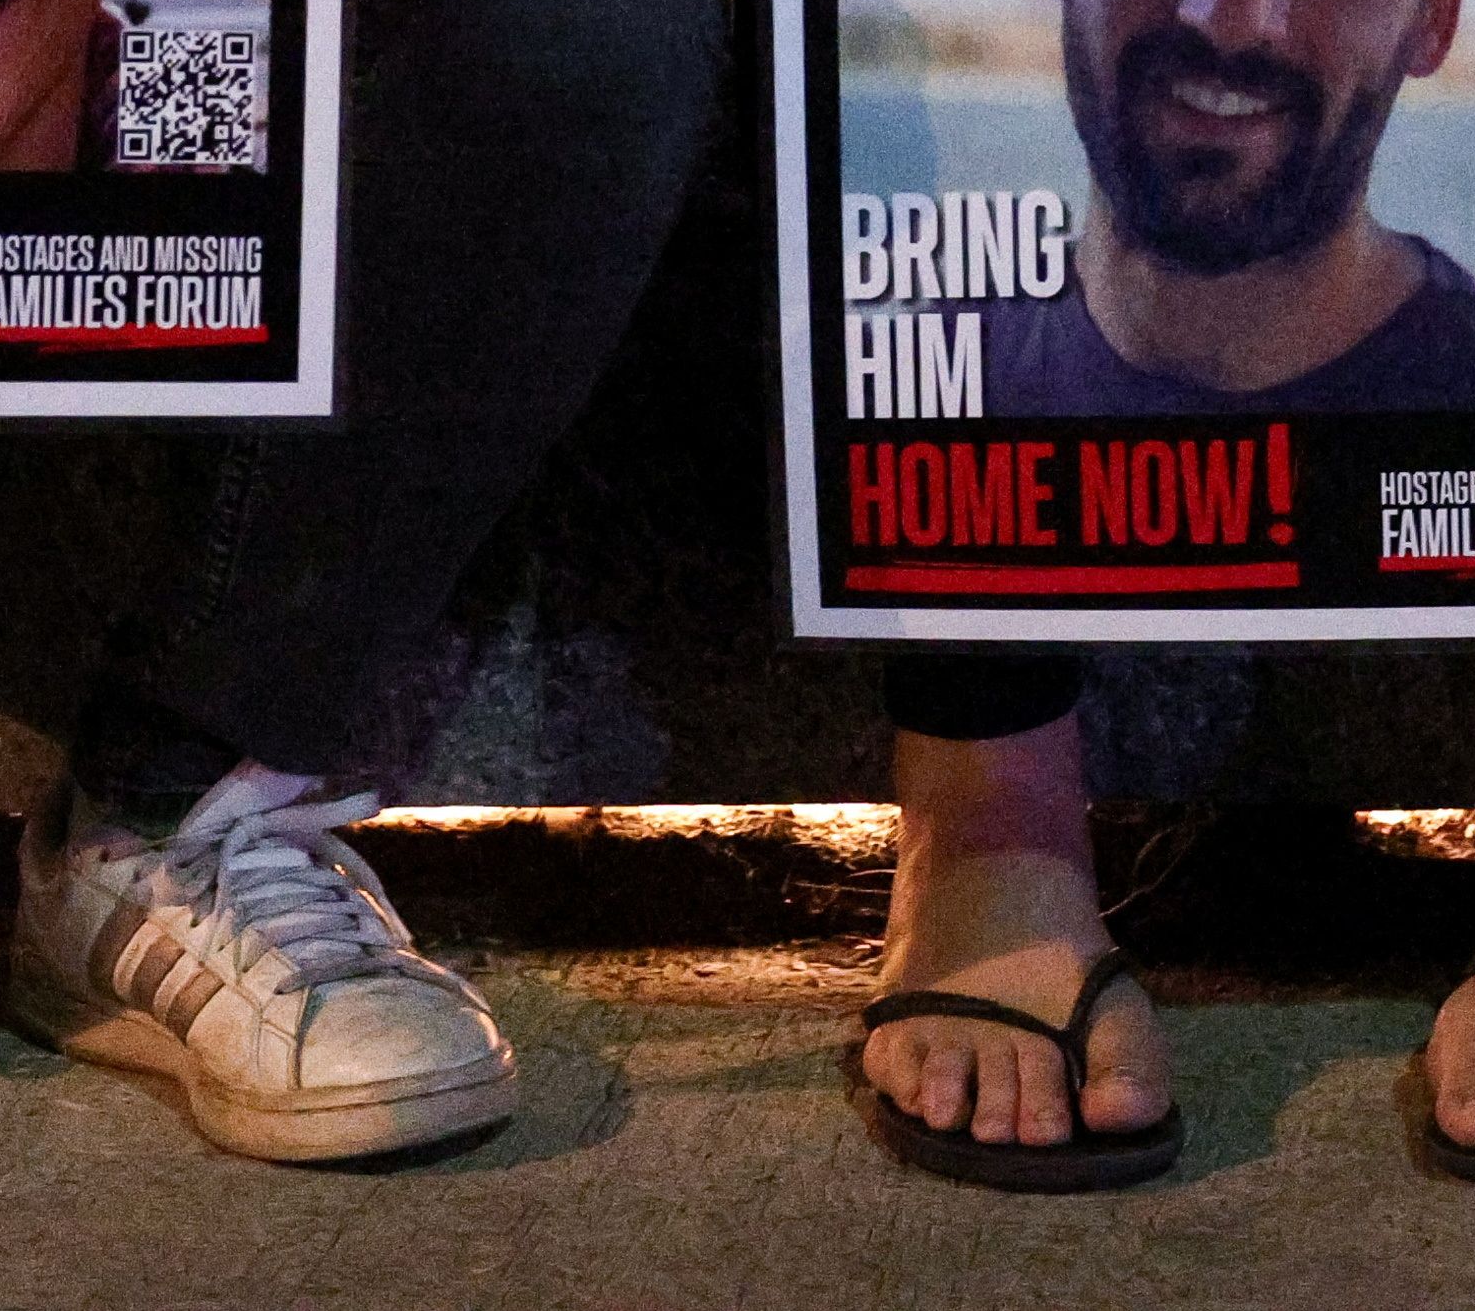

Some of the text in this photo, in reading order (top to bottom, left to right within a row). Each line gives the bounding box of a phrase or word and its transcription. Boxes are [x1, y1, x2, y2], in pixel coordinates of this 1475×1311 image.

[99, 237, 148, 273] AND
[154, 236, 262, 275] MISSING
[843, 190, 1066, 300] BRING
[136, 276, 261, 330] FORUM
[846, 313, 983, 419] HIM
[849, 423, 1294, 547] HOME NOW!
